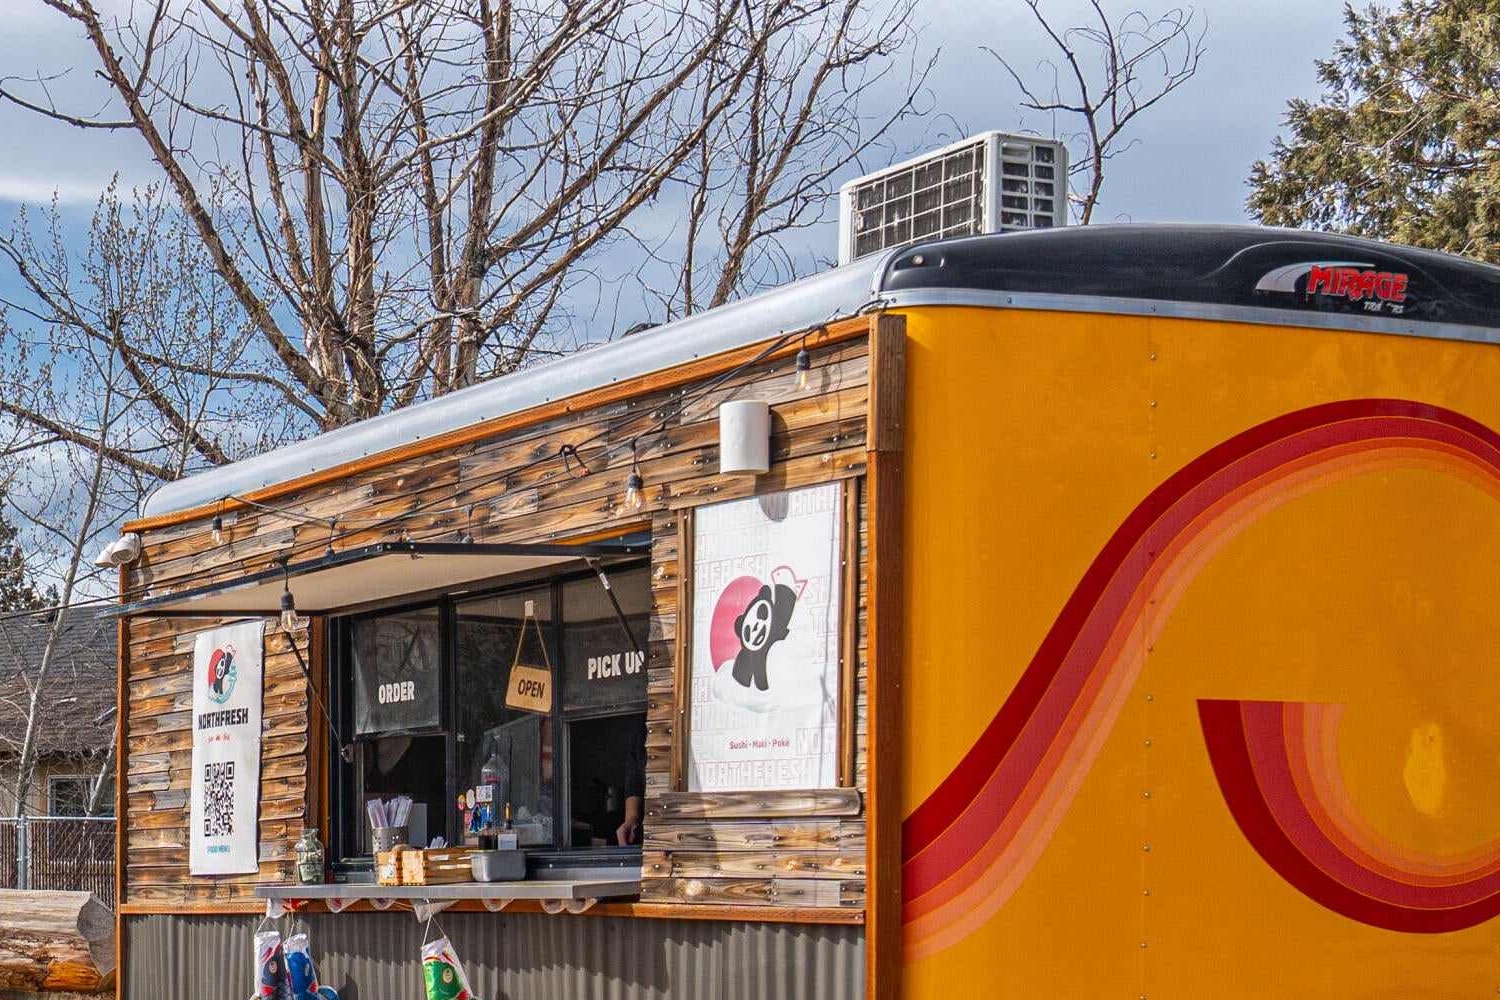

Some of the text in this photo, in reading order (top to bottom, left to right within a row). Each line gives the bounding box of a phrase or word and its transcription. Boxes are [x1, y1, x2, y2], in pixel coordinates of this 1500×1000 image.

[1307, 265, 1408, 302] MIRAGE
[587, 650, 645, 680] PICK UP
[378, 680, 415, 704] ORDER
[518, 679, 545, 699] OPEN
[198, 707, 249, 730] NORTHFRESH
[729, 740, 748, 750] Sushi
[752, 738, 768, 748] Maki
